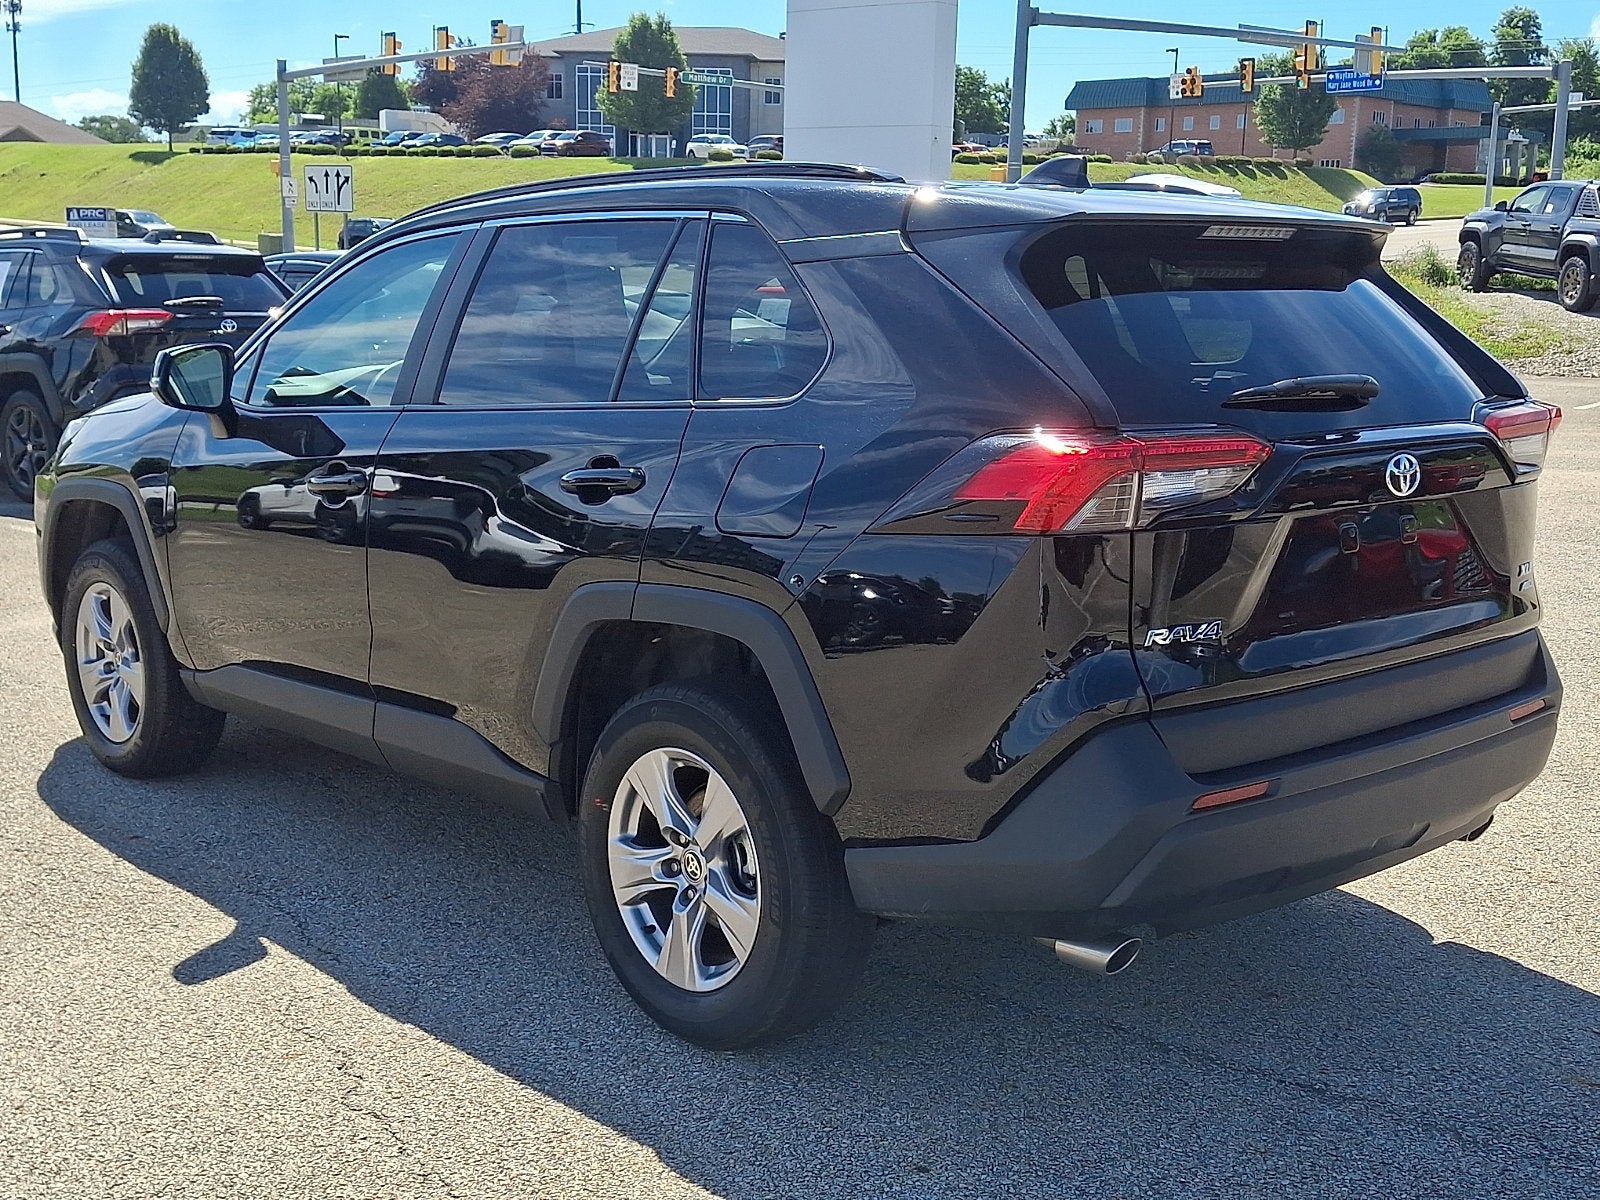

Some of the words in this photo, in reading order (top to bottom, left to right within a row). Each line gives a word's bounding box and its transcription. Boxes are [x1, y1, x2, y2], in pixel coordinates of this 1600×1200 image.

[688, 74, 716, 83] Matthew
[1335, 72, 1357, 81] Wayland
[1328, 82, 1339, 91] Mary
[1352, 80, 1366, 88] Wood
[79, 209, 104, 218] PRC
[1143, 620, 1223, 647] RAV4
